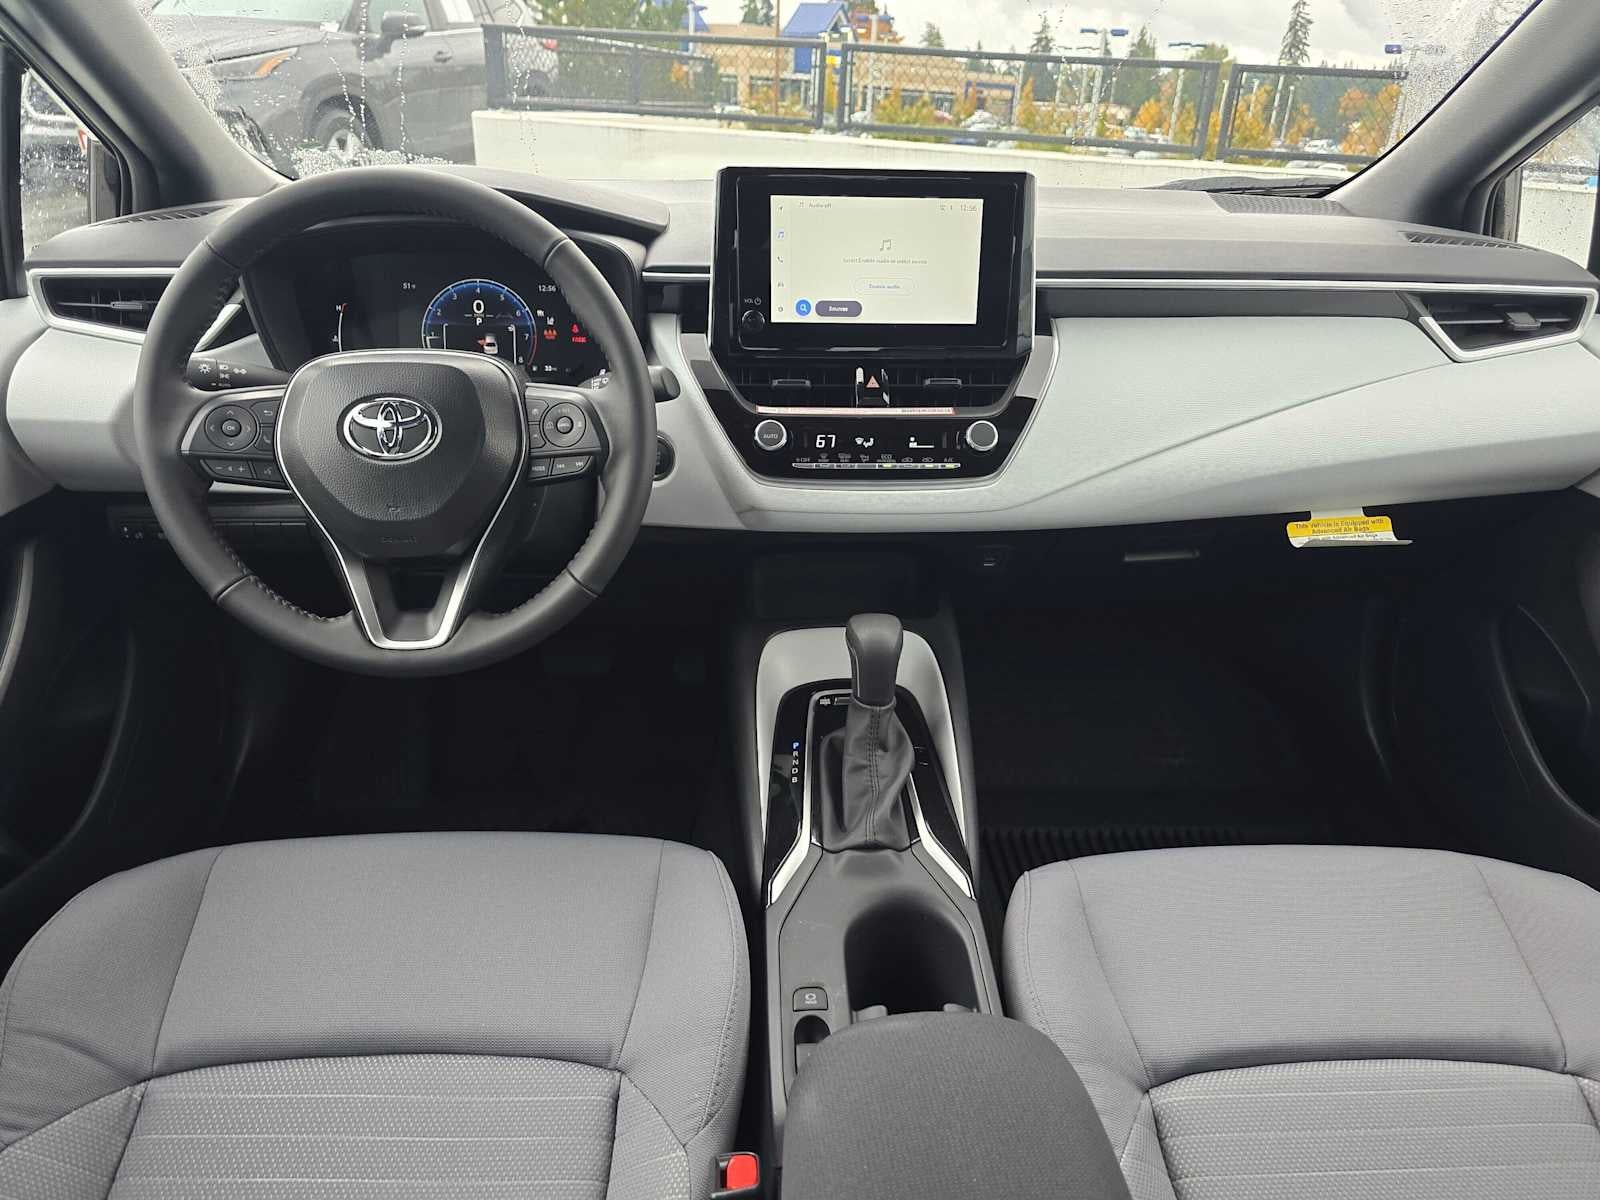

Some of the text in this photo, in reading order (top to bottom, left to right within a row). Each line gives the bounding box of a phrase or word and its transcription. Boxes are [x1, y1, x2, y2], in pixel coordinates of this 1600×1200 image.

[538, 284, 557, 292] 12:56
[476, 317, 483, 326] P
[815, 434, 836, 448] 67
[1341, 518, 1370, 527] Equipped
[1353, 525, 1370, 533] Bags
[792, 741, 800, 750] P
[791, 767, 799, 775] D
